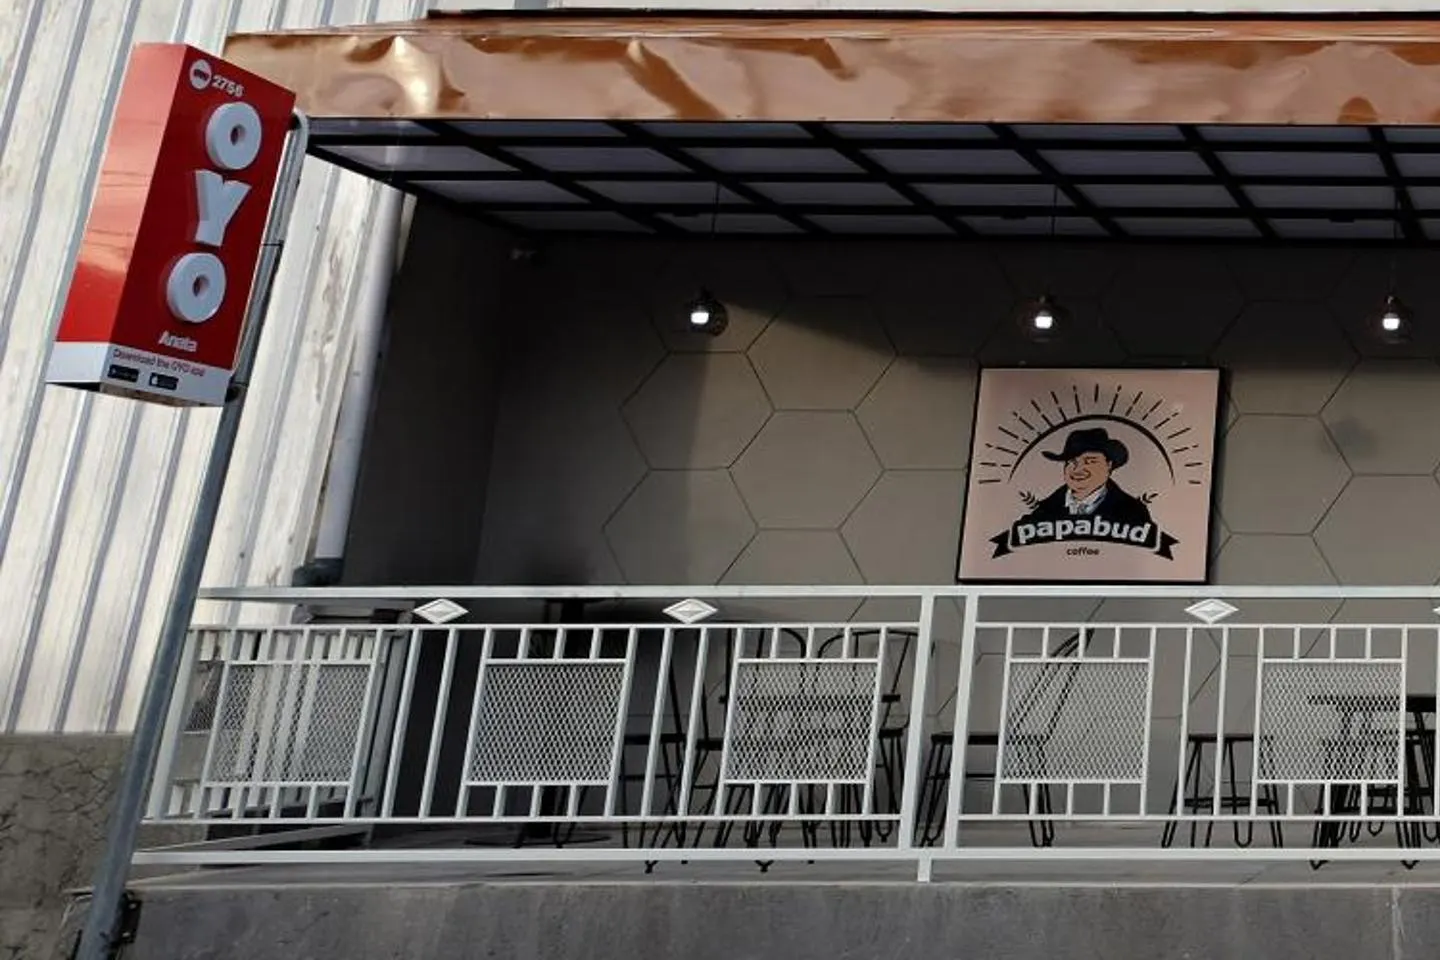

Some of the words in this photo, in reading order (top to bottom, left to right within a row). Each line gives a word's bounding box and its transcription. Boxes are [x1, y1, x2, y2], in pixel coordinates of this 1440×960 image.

[167, 101, 262, 323] OYO
[1017, 516, 1151, 544] papabud
[1066, 547, 1100, 556] coffee
